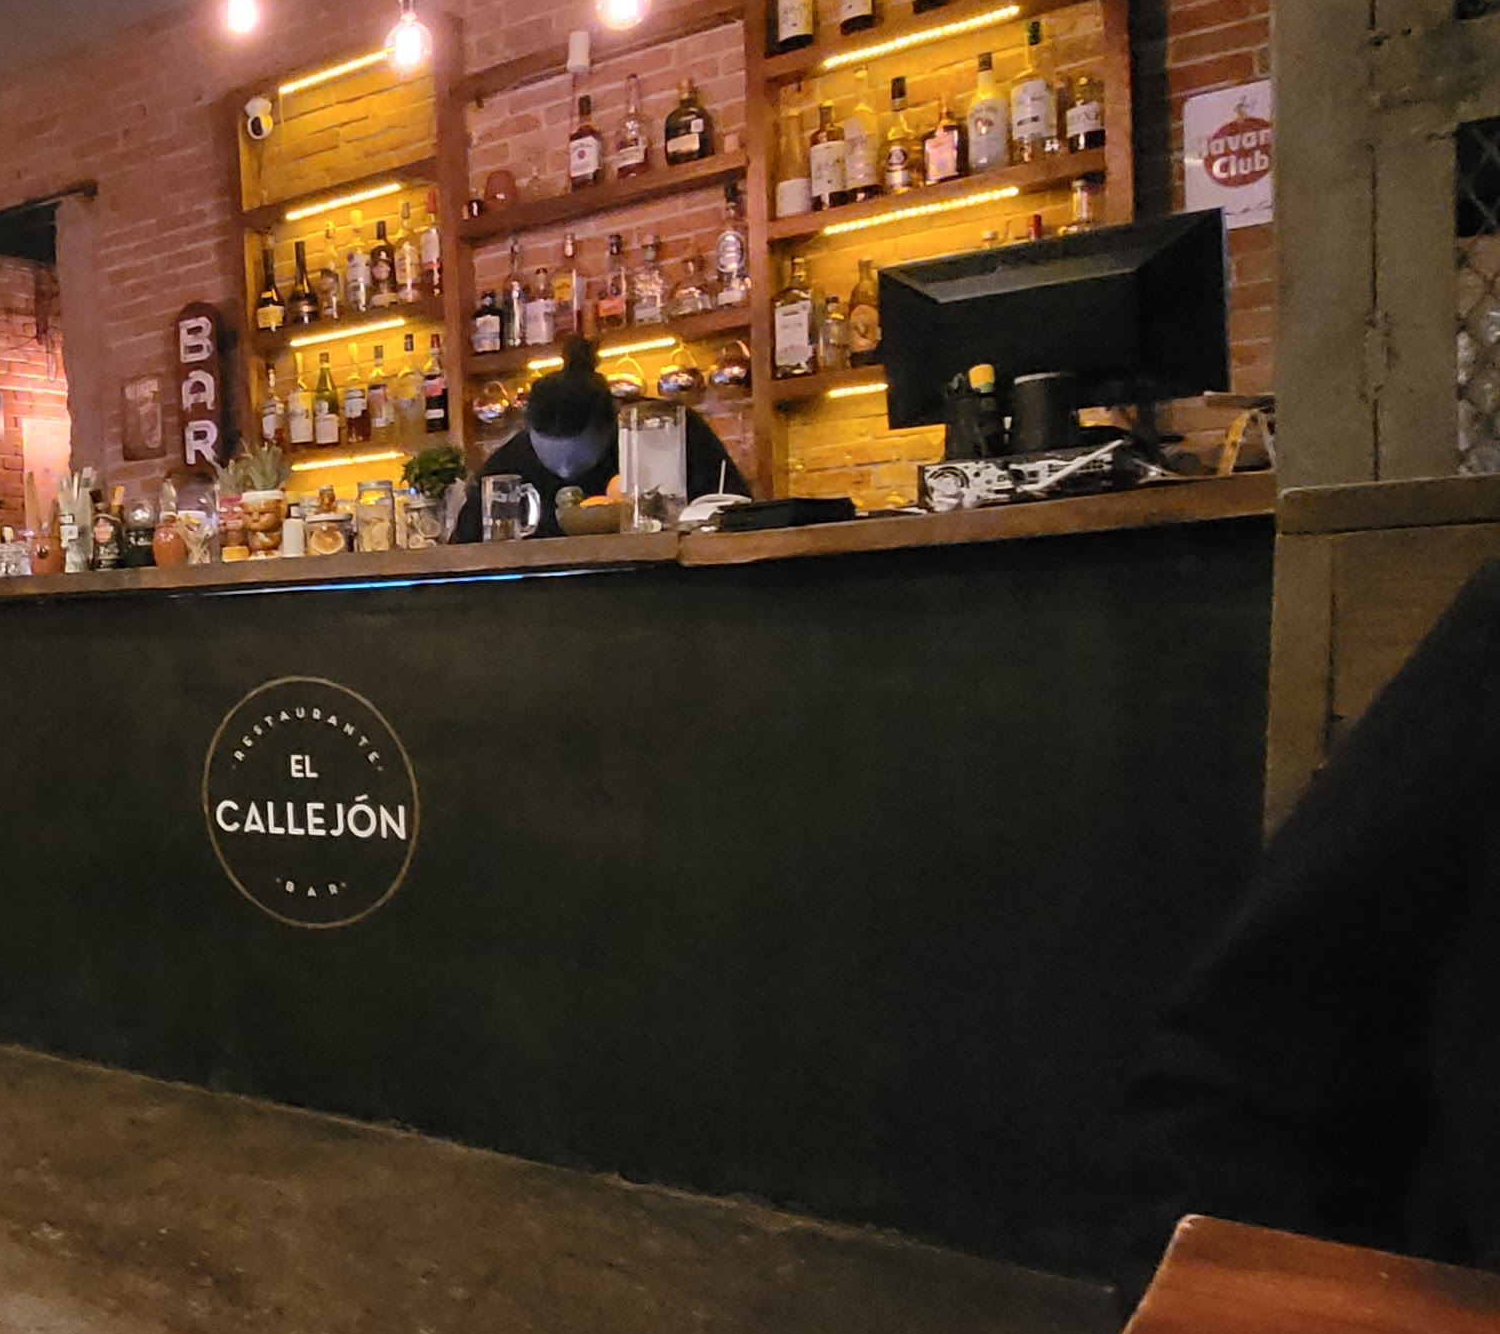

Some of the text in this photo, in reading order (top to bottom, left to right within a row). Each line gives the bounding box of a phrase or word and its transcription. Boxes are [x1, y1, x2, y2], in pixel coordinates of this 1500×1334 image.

[1212, 150, 1269, 179] Club
[178, 315, 220, 466] BAR
[233, 706, 381, 764] RESTAURANTE
[289, 754, 319, 779] EL
[215, 793, 407, 840] CALLEJÓN
[284, 880, 340, 898] BAR
